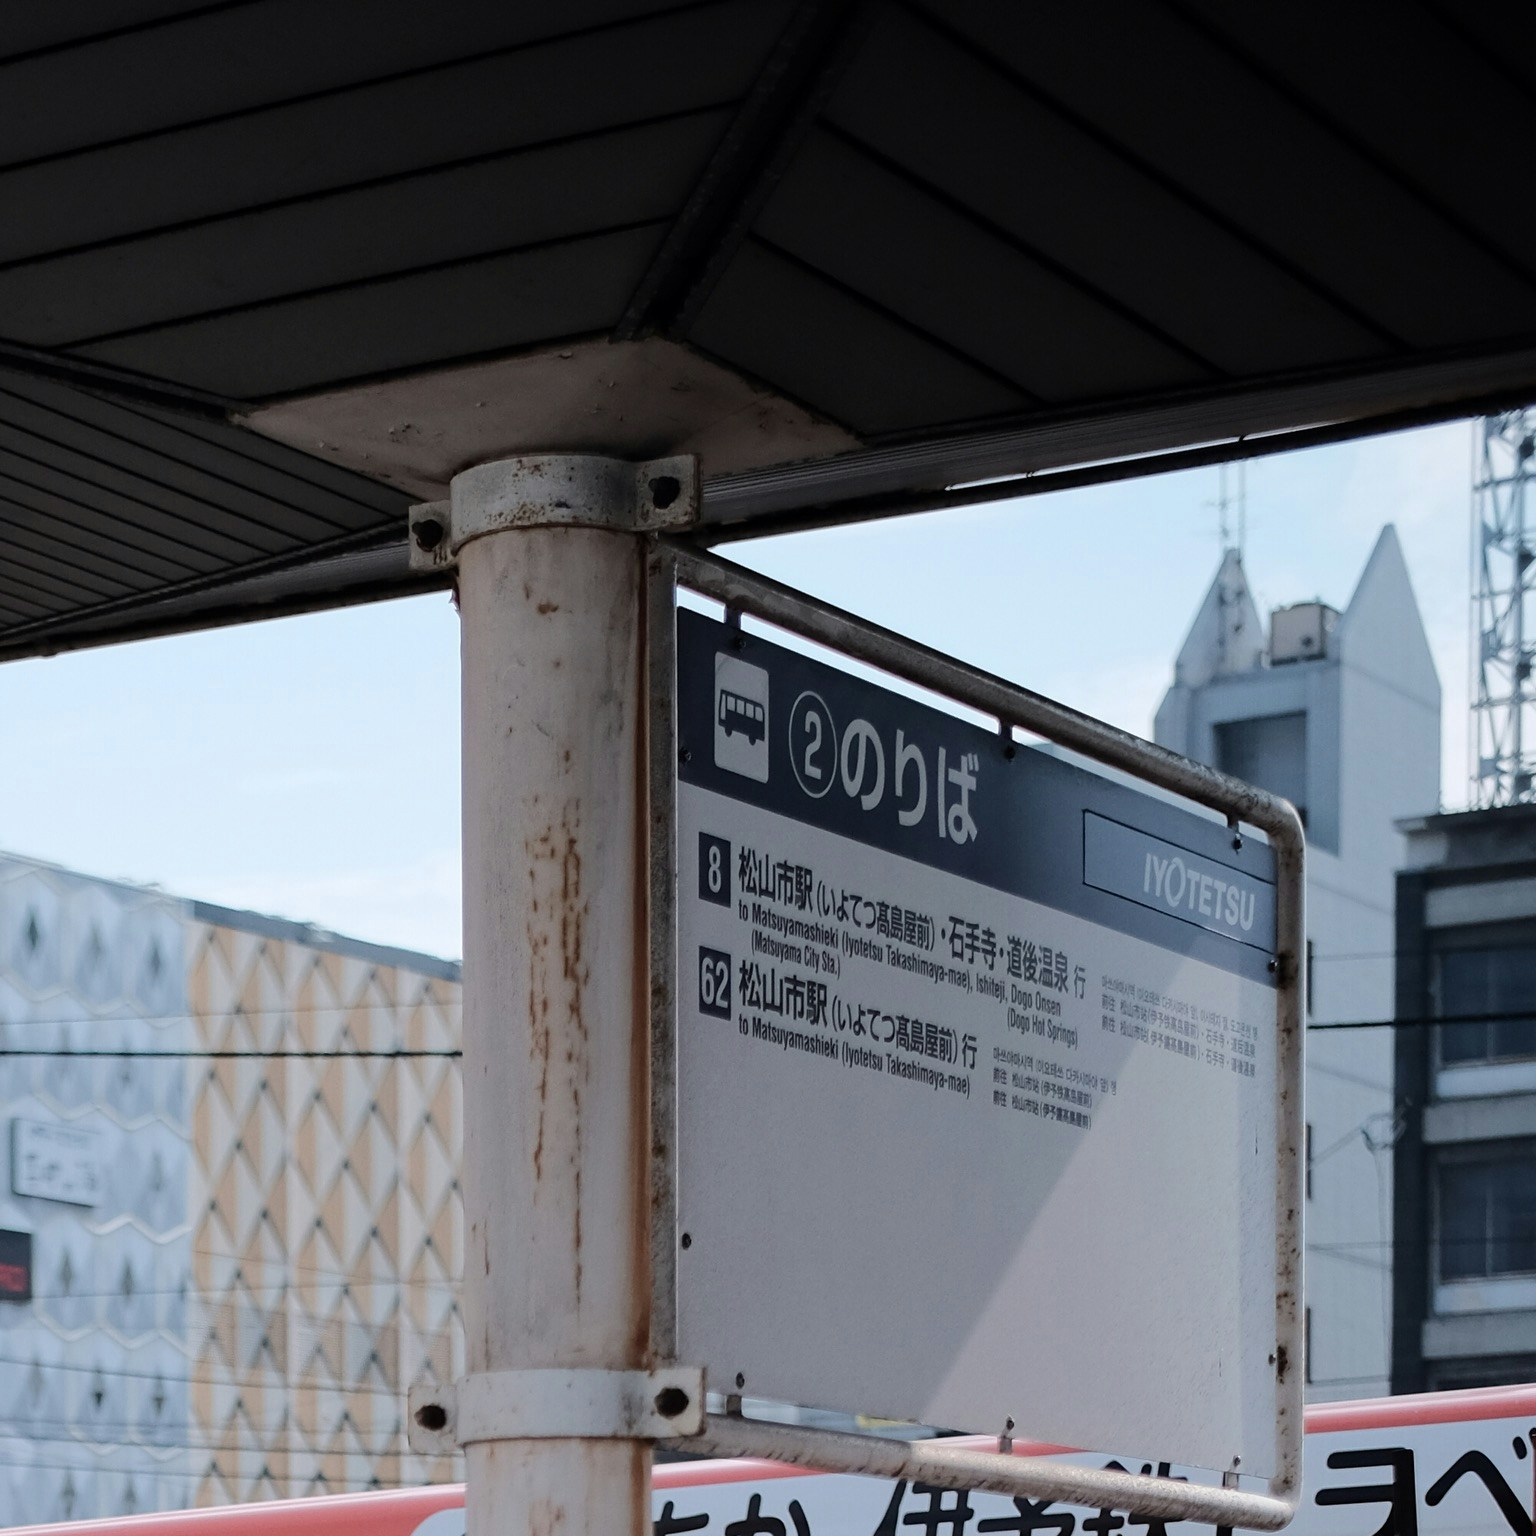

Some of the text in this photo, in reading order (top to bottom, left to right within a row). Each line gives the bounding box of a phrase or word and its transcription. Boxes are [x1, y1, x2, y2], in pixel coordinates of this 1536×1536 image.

[708, 845, 722, 894] 8
[1142, 852, 1255, 931] IYOTETSU
[738, 899, 1061, 1017] to Matsuyamashieki (Iyotetsu Takashimaya-mae), Ishiteji, Dogo Onsen
[751, 929, 841, 981] (Matsuyama City Sta.)
[701, 956, 729, 1009] 62
[1007, 1006, 1078, 1050] (Dogo Hot Springs)
[738, 1013, 970, 1100] to Matsuyamashieki (Iyotetsu Takashimaya-mae)
